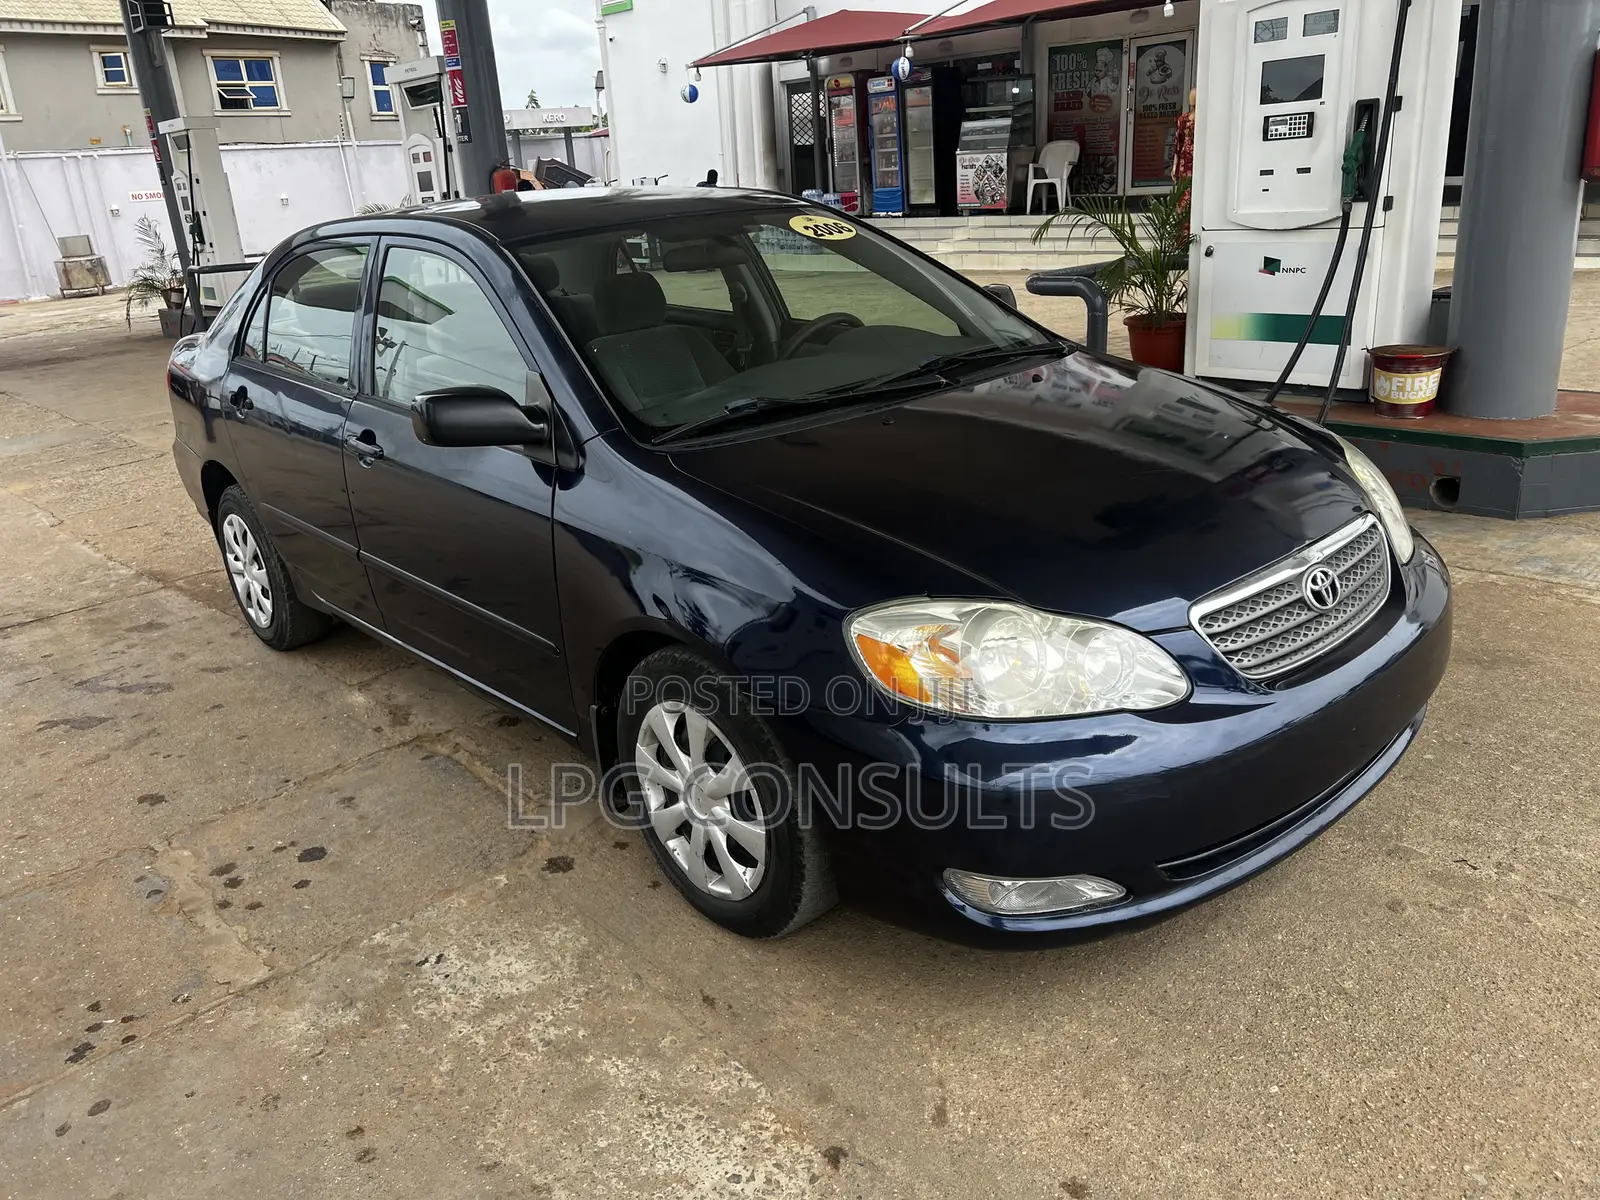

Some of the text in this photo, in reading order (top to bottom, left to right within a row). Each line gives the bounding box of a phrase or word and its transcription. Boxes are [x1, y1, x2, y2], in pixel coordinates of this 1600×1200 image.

[1054, 51, 1088, 71] 100%
[1051, 70, 1090, 91] FRESH
[1142, 102, 1177, 112] 100% FRESH
[543, 113, 566, 123] KERO
[803, 222, 853, 237] 2006
[1392, 372, 1439, 391] FIRE
[1390, 387, 1438, 400] BUCKET
